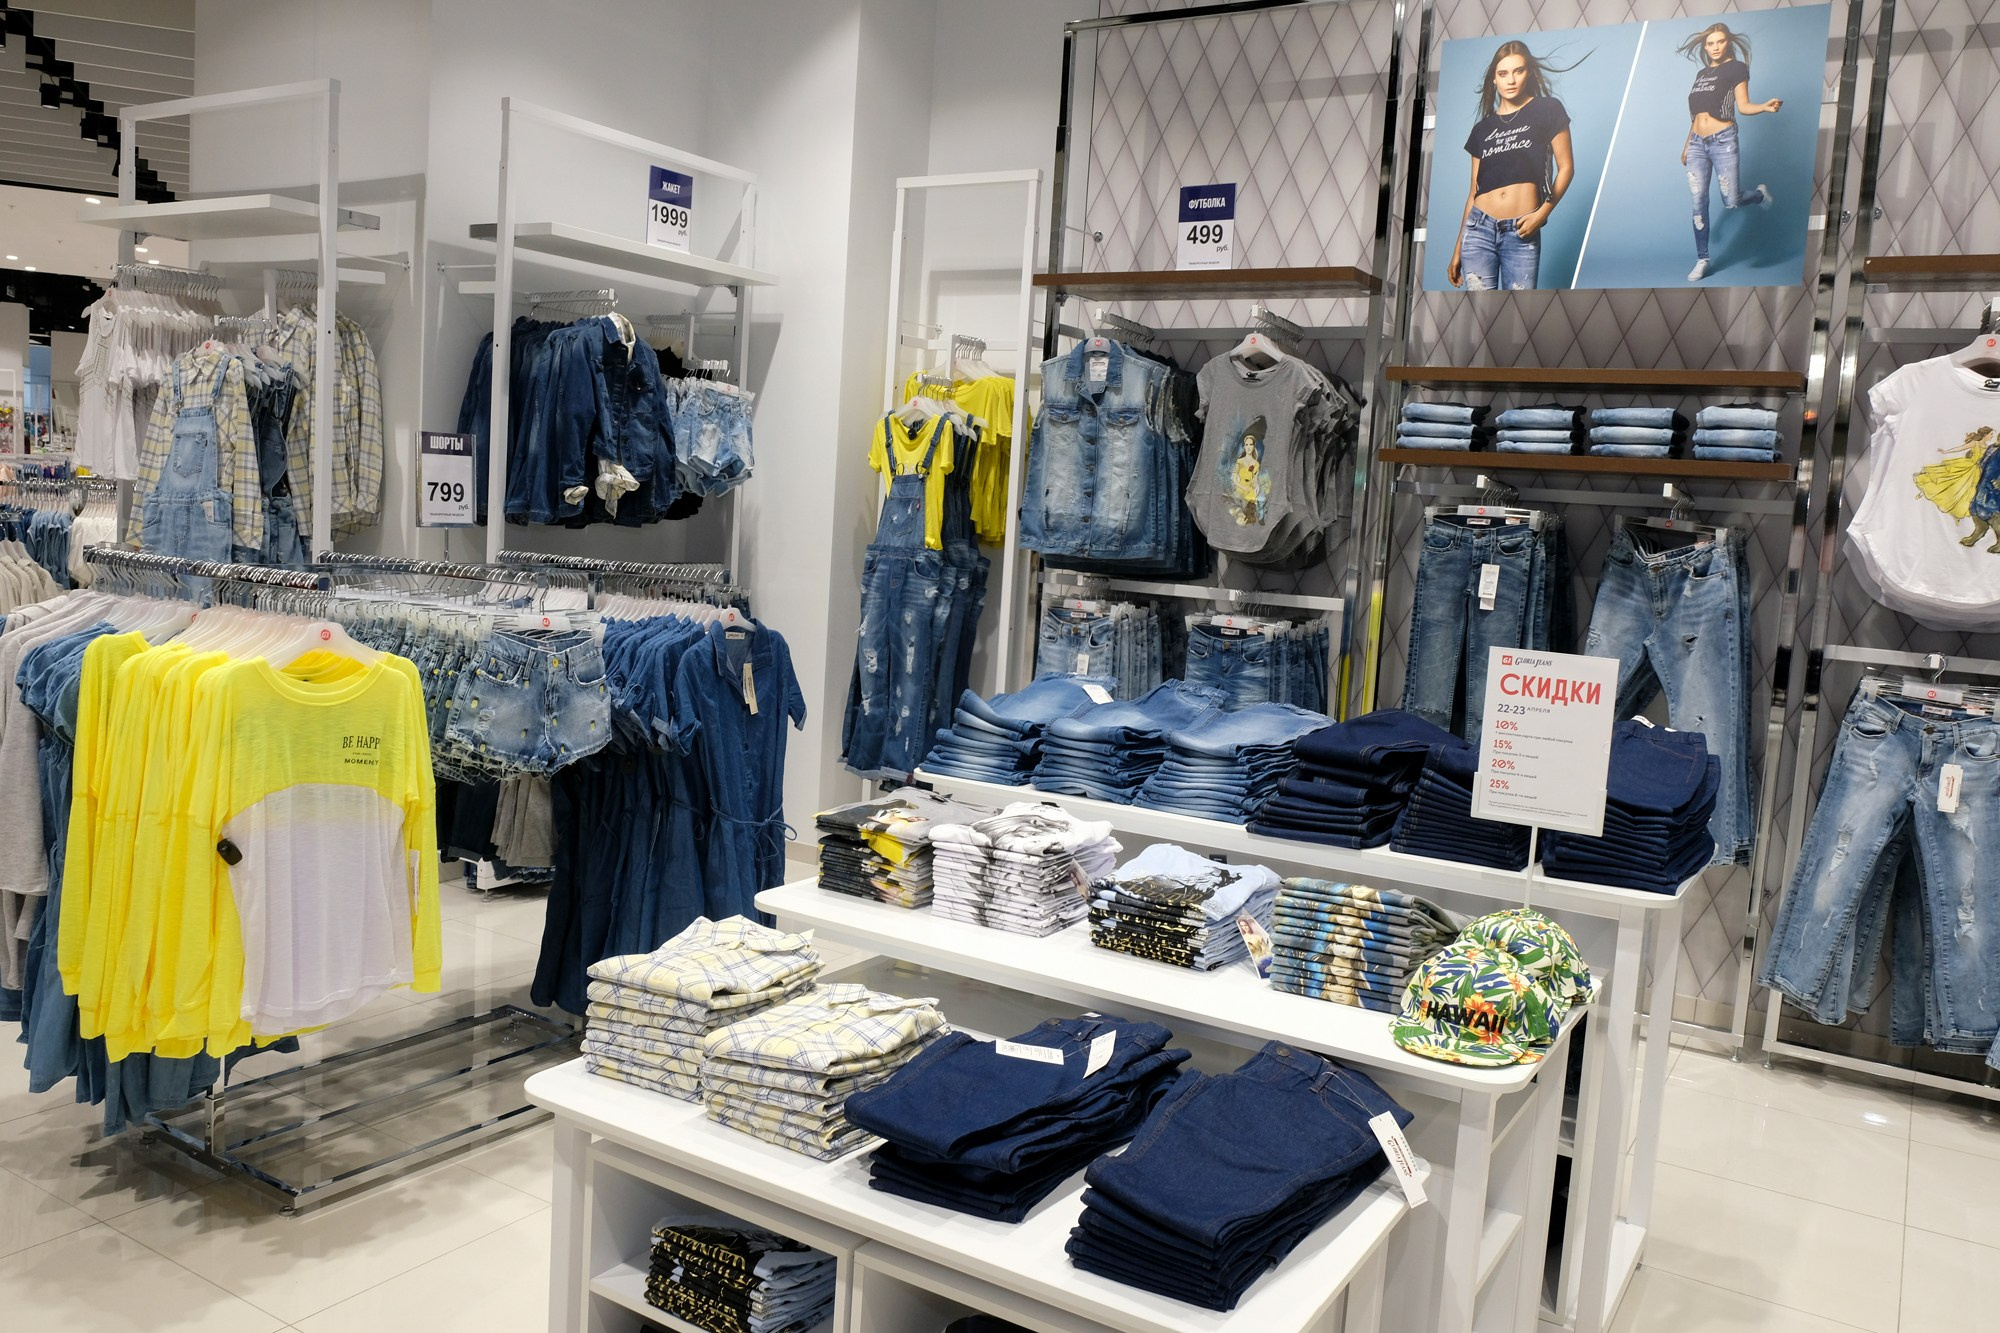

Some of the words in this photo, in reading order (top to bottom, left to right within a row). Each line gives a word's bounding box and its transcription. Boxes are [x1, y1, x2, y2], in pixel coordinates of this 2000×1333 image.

[1481, 139, 1533, 159] romance
[661, 180, 681, 195] ЖАКЕТ
[1188, 197, 1226, 209] ФУТБОЛКА
[651, 203, 688, 228] 1999
[1186, 224, 1223, 244] 499
[430, 435, 464, 451] ШОРТЫ
[427, 481, 465, 502] 799
[1515, 657, 1535, 665] GLORIA
[1534, 660, 1552, 668] JEANS
[1500, 673, 1601, 706] СКИДКИ
[1497, 703, 1526, 715] 22-23
[1495, 720, 1518, 731] 10%
[342, 735, 354, 749] BE
[356, 735, 381, 750] HAPP
[1493, 739, 1513, 750] 15%
[344, 758, 379, 766] MOMENT
[1491, 758, 1515, 770] 20%
[1489, 778, 1510, 790] 25%
[1426, 1000, 1506, 1034] HAWAII
